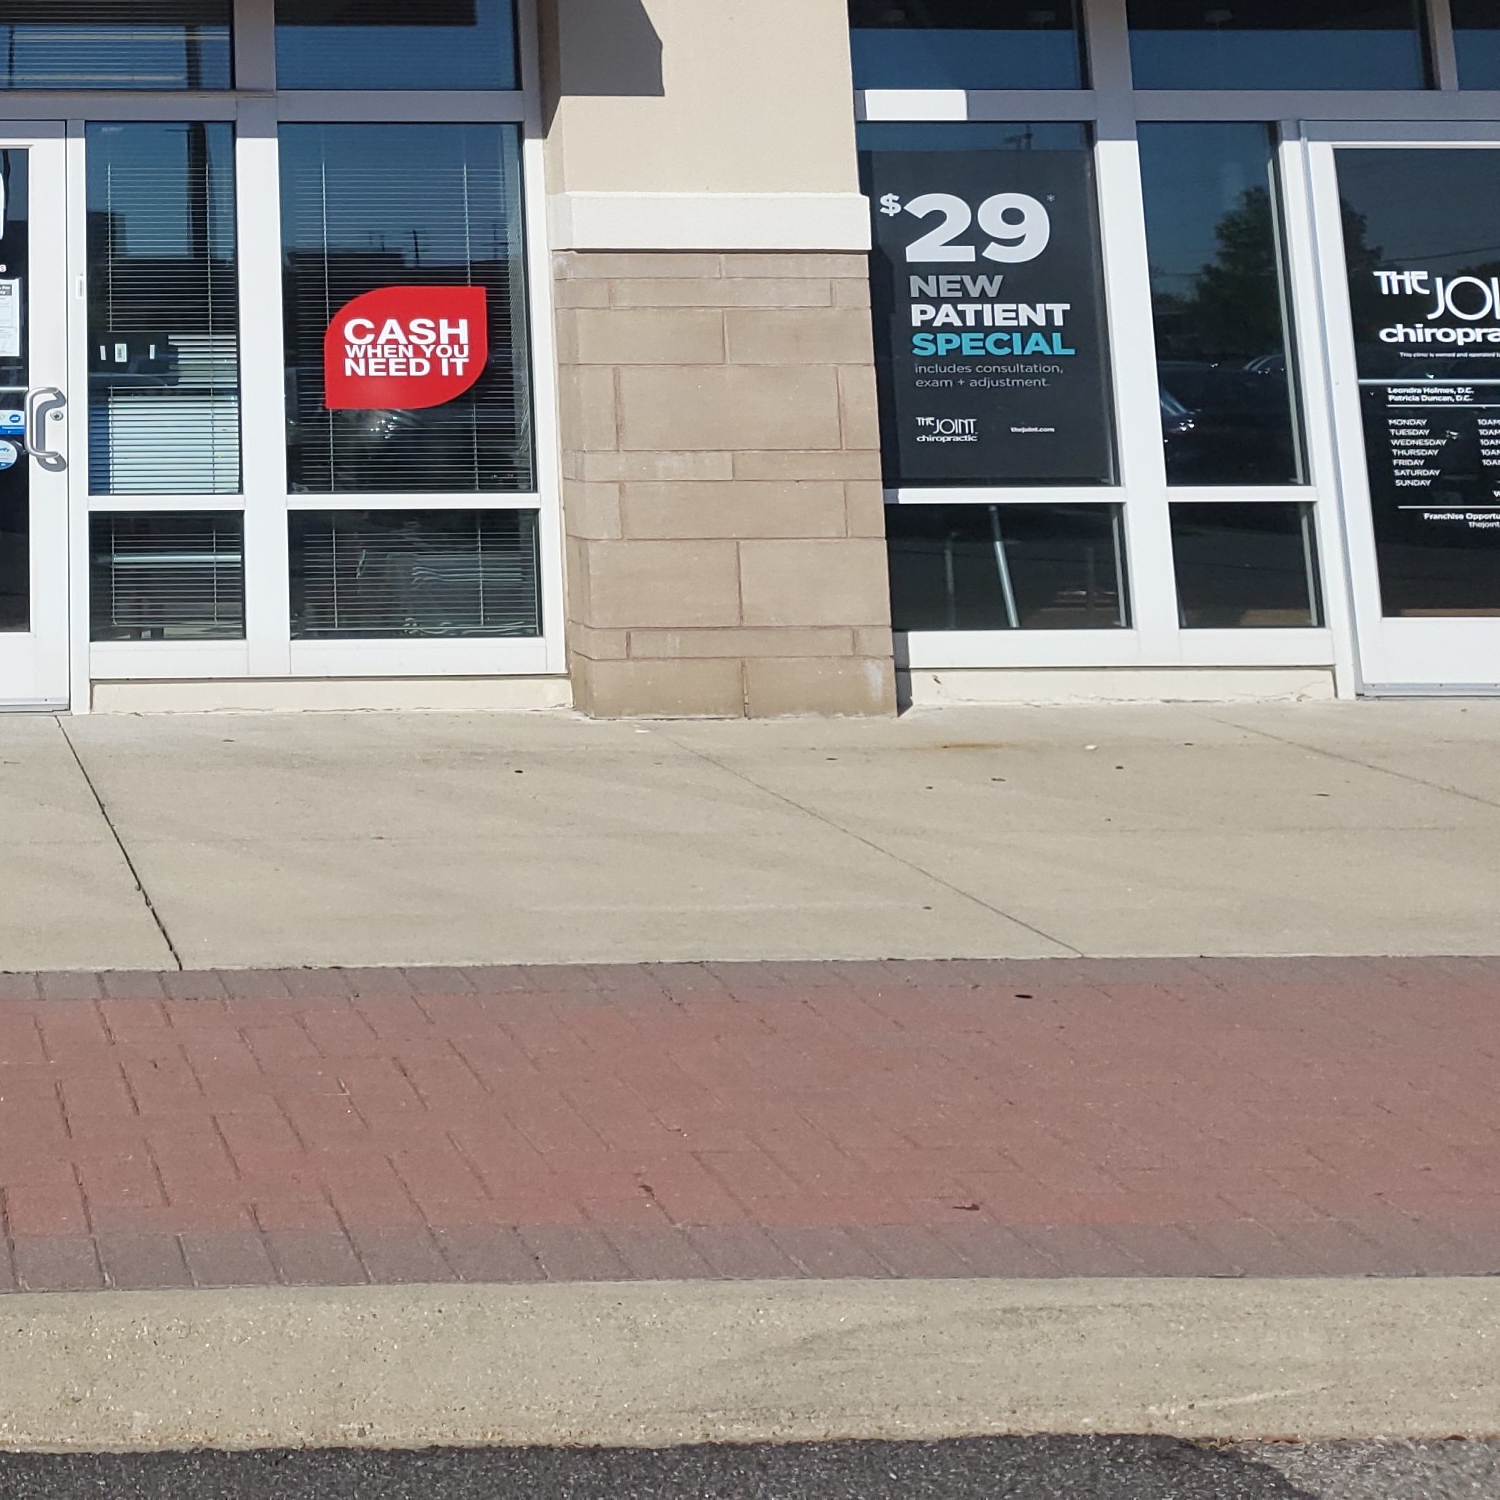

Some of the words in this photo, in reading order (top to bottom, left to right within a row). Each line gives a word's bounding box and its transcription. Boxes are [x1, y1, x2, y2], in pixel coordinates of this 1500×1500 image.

[909, 275, 1004, 298] NEW
[1373, 271, 1430, 295] THE
[911, 304, 1070, 327] PATIENT
[344, 318, 468, 345] CASH
[345, 345, 413, 358] WHEN
[420, 344, 469, 358] YOU
[912, 333, 1075, 356] SPECIAL
[345, 358, 430, 376] NEED
[441, 358, 469, 376] IT
[915, 364, 972, 373] includes
[975, 363, 1063, 374] consultation,
[915, 379, 953, 388] exam
[969, 377, 1049, 389] adjustment.
[916, 417, 935, 426] THE
[933, 418, 978, 434] JOINT
[916, 435, 978, 443] chiropractic
